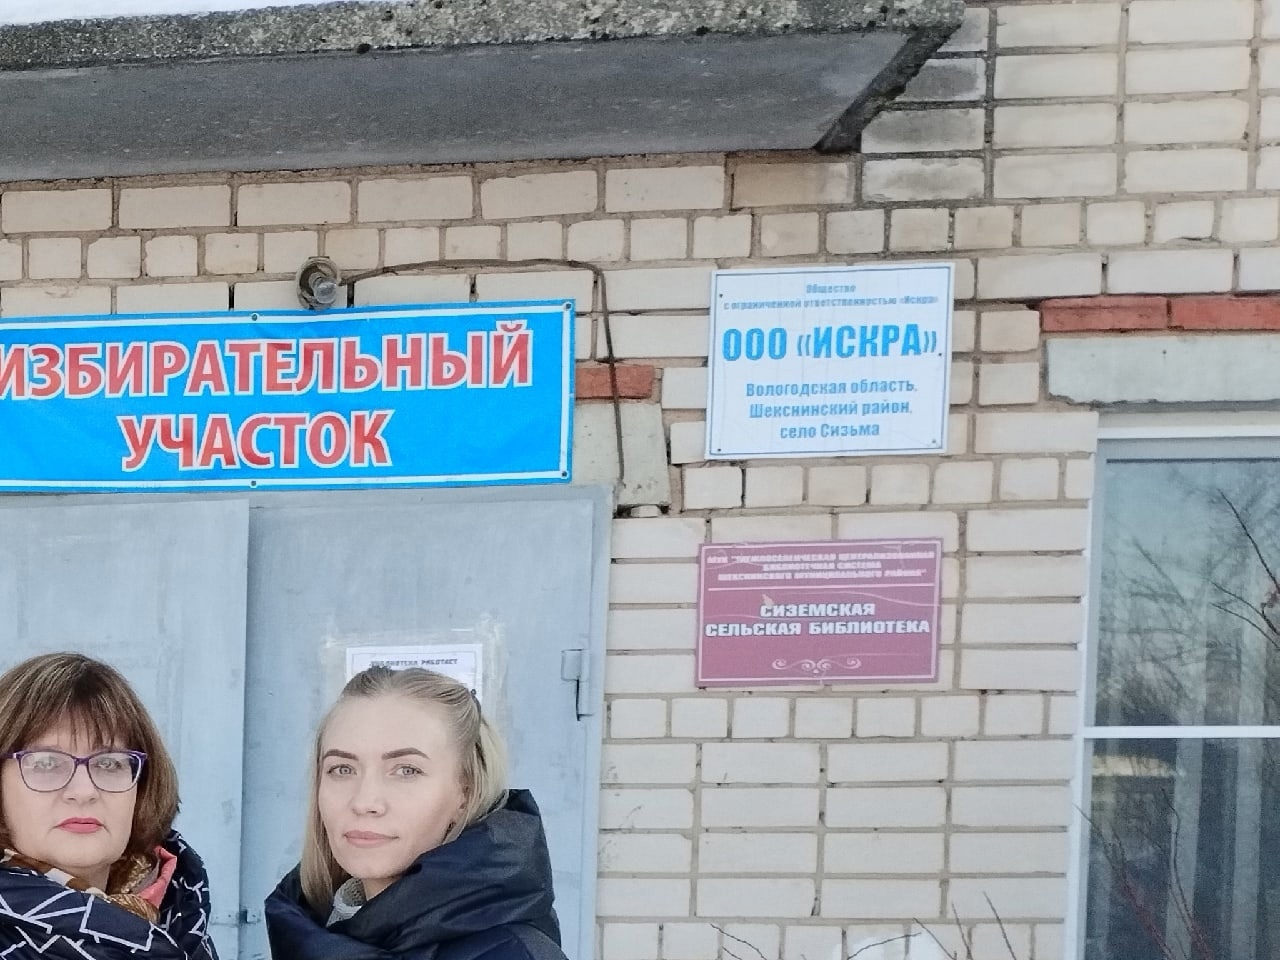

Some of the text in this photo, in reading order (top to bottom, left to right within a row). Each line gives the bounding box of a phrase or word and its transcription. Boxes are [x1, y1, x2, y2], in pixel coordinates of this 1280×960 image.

[722, 323, 937, 361] ООО «ИСКРА»
[746, 382, 846, 397] Вологодская
[749, 401, 858, 418] Шекснинский
[780, 423, 880, 439] село Сизьма
[119, 409, 395, 471] УЧАСТОК
[760, 603, 876, 618] СИЗЕМСКАЯ
[705, 619, 930, 637] СЕЛЬСКАЯ БИБЛИОТЕКА
